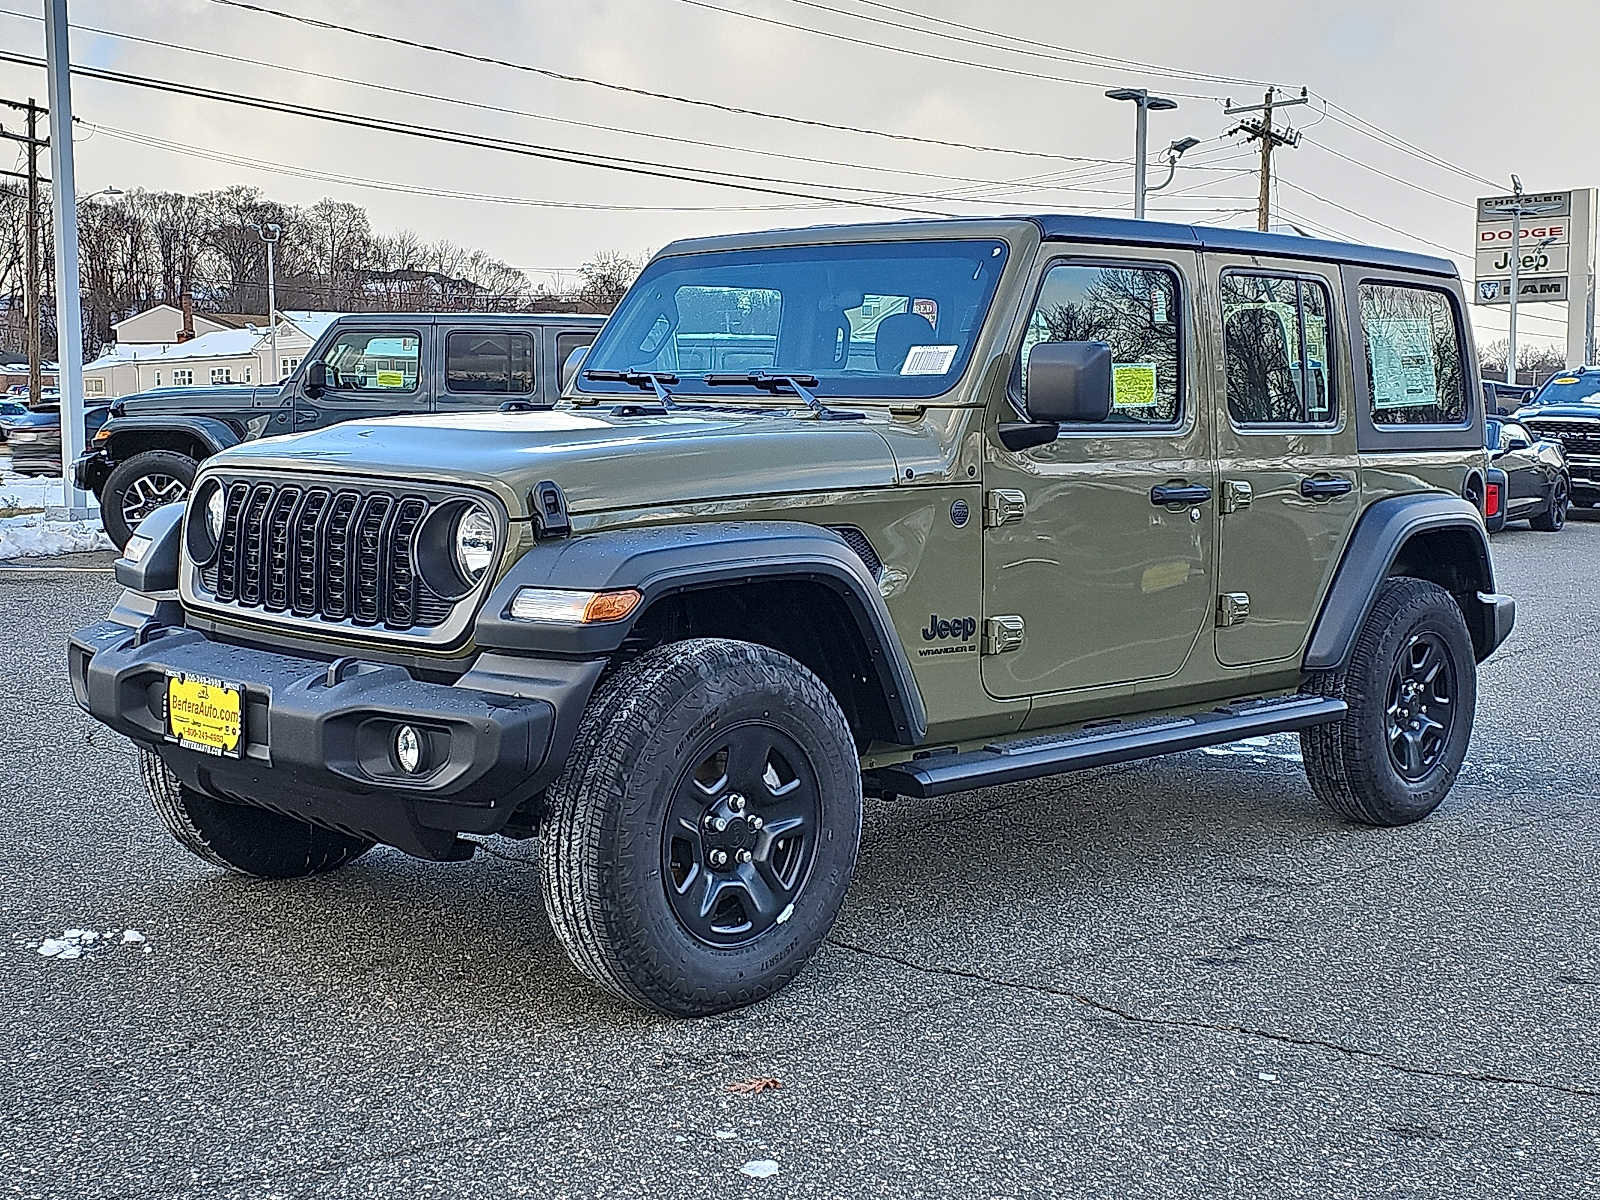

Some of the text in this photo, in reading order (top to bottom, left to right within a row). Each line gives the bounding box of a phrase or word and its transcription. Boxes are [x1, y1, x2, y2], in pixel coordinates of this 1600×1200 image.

[1481, 226, 1563, 241] DODGE
[921, 614, 977, 641] Jeep
[918, 646, 967, 656] WRANGLER
[172, 695, 239, 723] BerteraAuto.com
